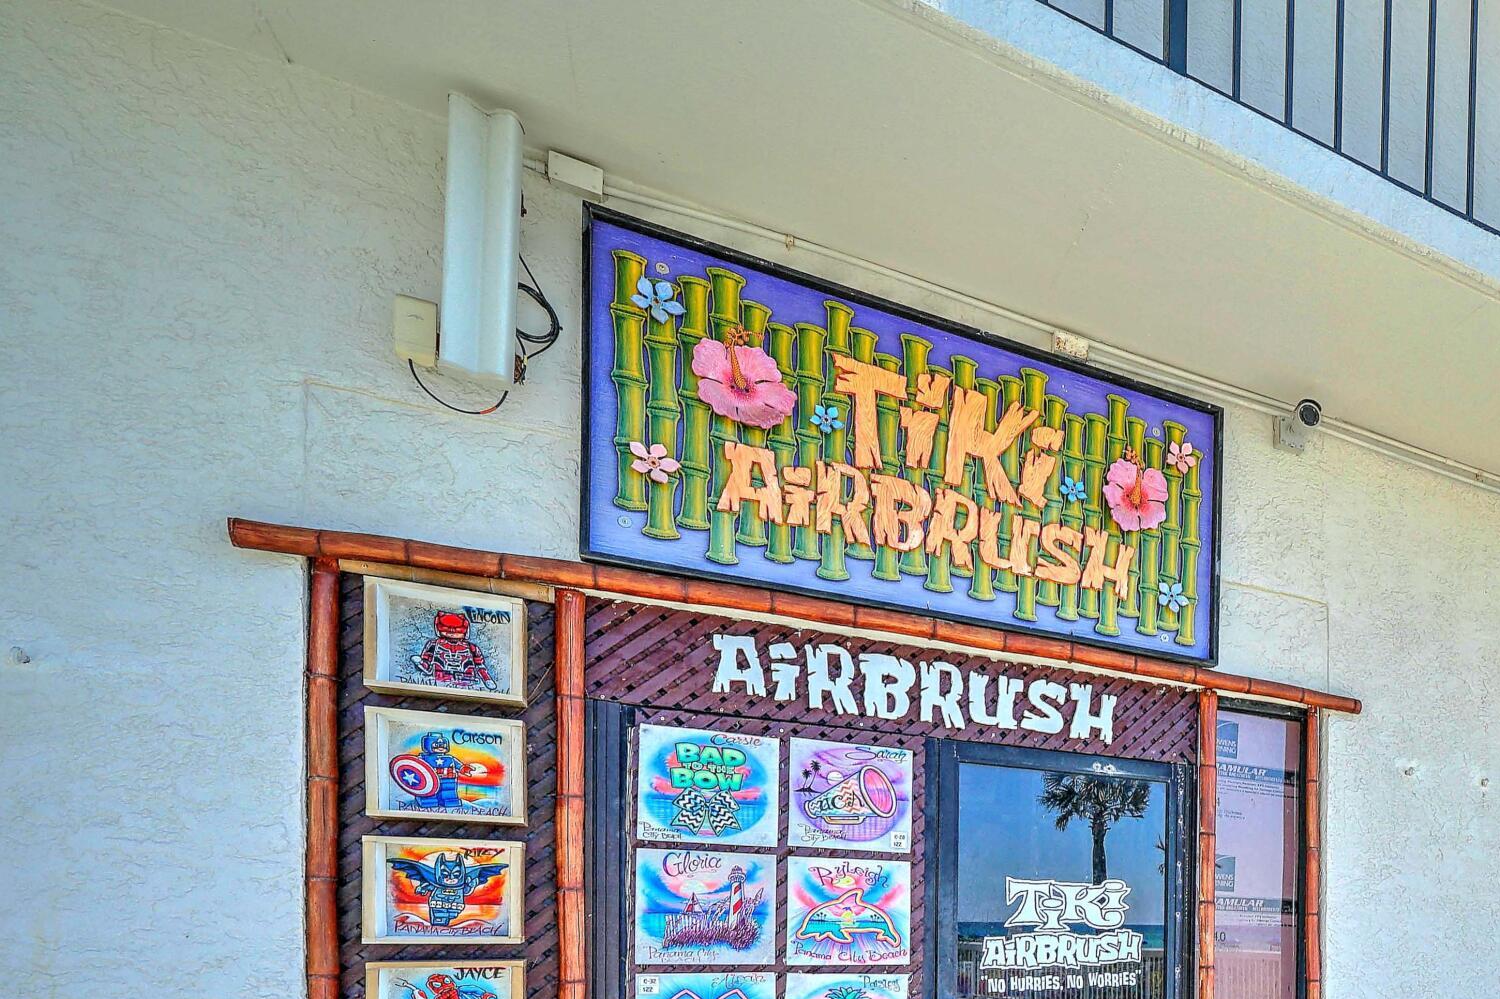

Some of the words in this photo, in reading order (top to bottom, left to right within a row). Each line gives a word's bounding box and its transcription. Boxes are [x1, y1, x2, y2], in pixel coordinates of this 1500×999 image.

[832, 353, 1064, 511] TiKi
[715, 440, 1134, 601] AiRBRUSH
[711, 634, 1118, 745] AiRBRUSH
[452, 729, 502, 745] Carson
[1217, 739, 1237, 748] WENS
[675, 742, 747, 767] BAD
[845, 746, 908, 762] Sarah
[683, 761, 703, 771] TO
[707, 764, 736, 776] THE
[1215, 763, 1267, 776] AMULAR
[670, 767, 744, 792] BOW
[662, 851, 722, 877] Gloria
[1215, 898, 1264, 908] AMULAR
[394, 919, 440, 935] PANAMA
[790, 941, 832, 961] Panama
[980, 928, 1143, 970] AiRBRUSH
[453, 967, 506, 981] JAYCE
[1066, 974, 1084, 989] NO
